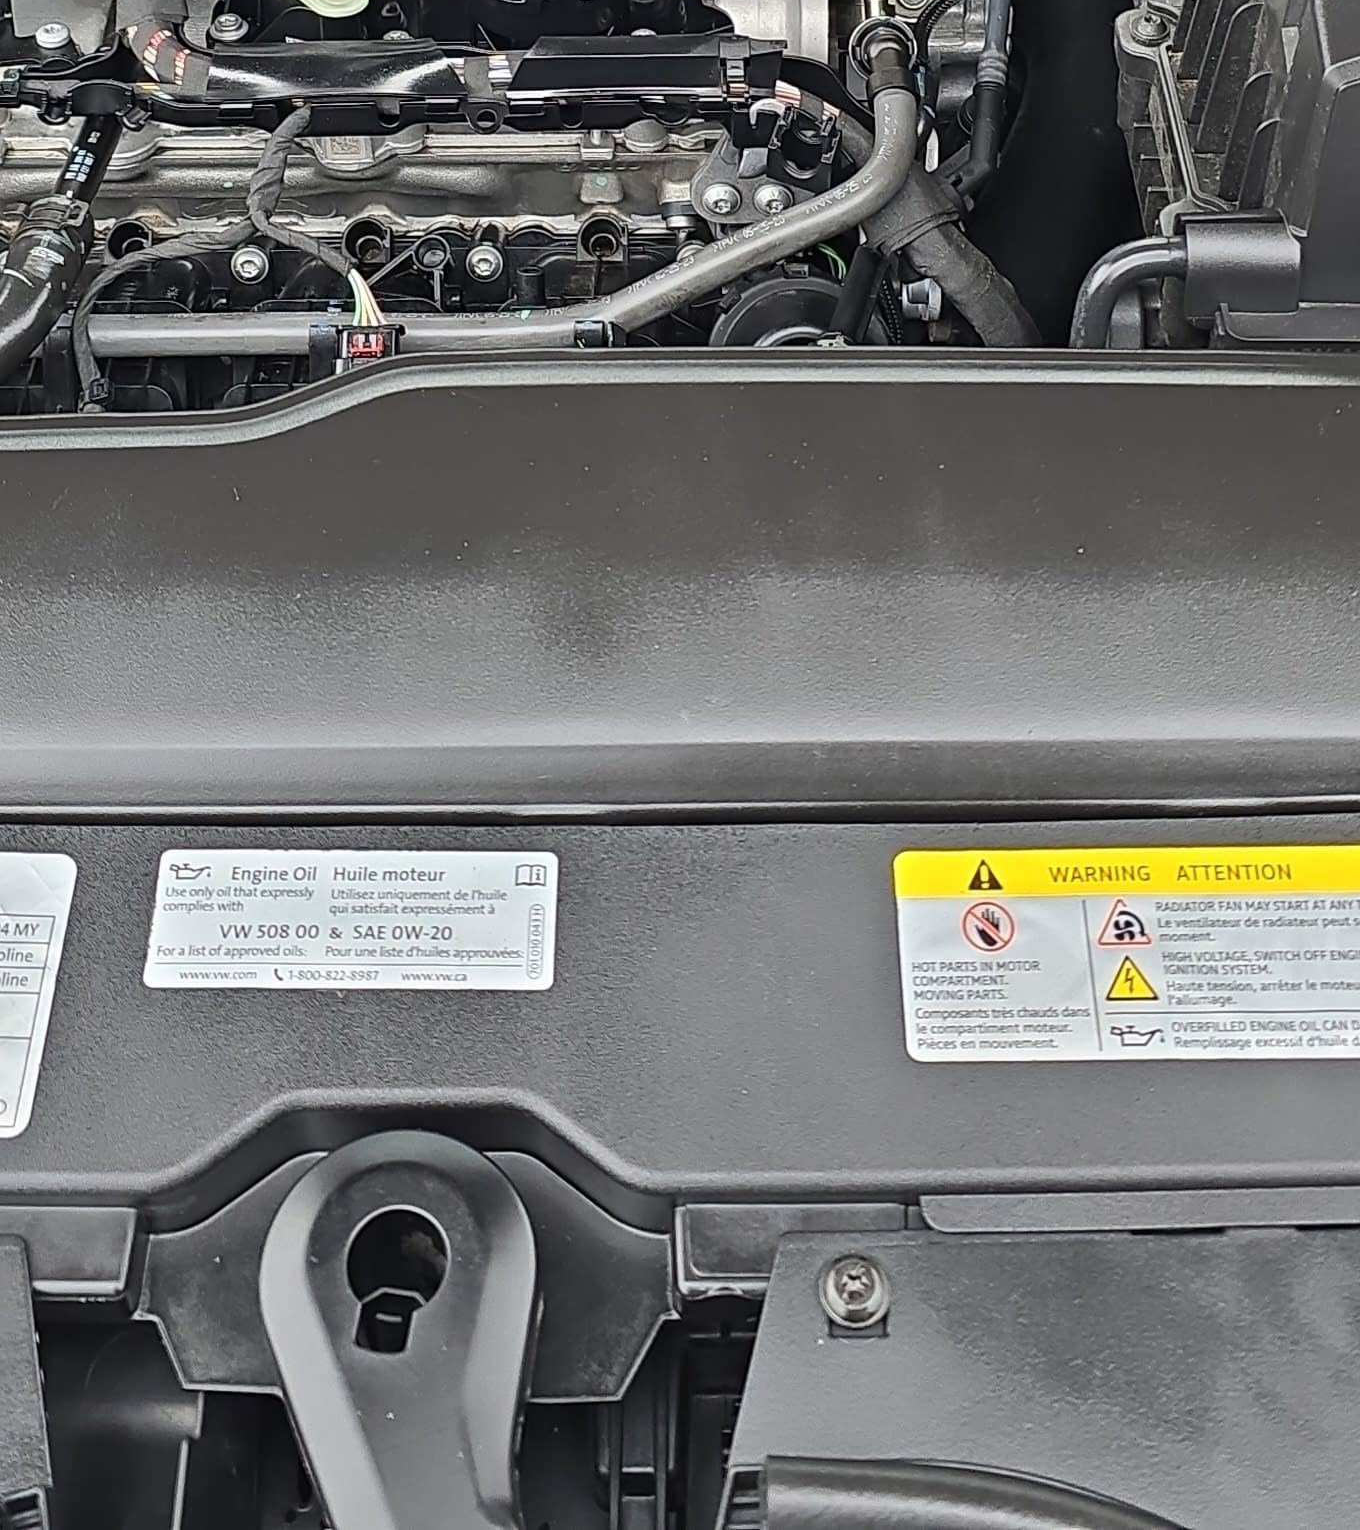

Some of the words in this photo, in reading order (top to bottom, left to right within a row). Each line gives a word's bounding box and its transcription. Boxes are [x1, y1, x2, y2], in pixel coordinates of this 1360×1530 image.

[231, 866, 289, 885] Engine
[293, 866, 317, 881] Oil
[333, 866, 378, 882] Huile
[382, 868, 445, 882] moteur
[1049, 865, 1150, 883] WARNING
[1177, 864, 1291, 881] ATTENTION
[165, 886, 187, 898] Use
[188, 886, 215, 901] only
[216, 886, 232, 898] oil
[233, 886, 258, 898] that
[260, 886, 314, 901] expressly
[331, 888, 375, 900] Utilisez
[377, 889, 451, 902] uniquement
[453, 889, 469, 901] de
[471, 889, 508, 901] l'huile
[163, 900, 215, 914] complies
[217, 900, 244, 912] with
[329, 903, 349, 917] qui
[351, 902, 399, 914] satisfait
[401, 903, 485, 917] expressément
[487, 903, 496, 915] à
[1155, 901, 1215, 912] RADIATOR
[1217, 900, 1243, 911] FAN
[1245, 901, 1271, 912] MAY
[1273, 900, 1309, 912] START
[1312, 899, 1326, 911] AT
[1329, 900, 1354, 910] ANY
[13, 923, 40, 936] MY
[1157, 917, 1173, 929] Le
[1174, 917, 1241, 928] ventilateur
[1244, 916, 1260, 928] de
[1262, 916, 1319, 928] radiateur
[1321, 917, 1352, 928] peut
[220, 924, 253, 939] VW
[257, 924, 290, 939] 508
[295, 924, 320, 939] 00
[329, 926, 343, 940] &
[353, 925, 386, 940] SAE
[392, 925, 453, 941] 0W-20
[1159, 932, 1216, 942] moment.
[156, 945, 176, 957] For
[177, 947, 186, 957] a
[188, 944, 206, 957] list
[208, 944, 223, 957] of
[223, 944, 281, 959] approved
[282, 945, 307, 957] oils:
[325, 945, 353, 957] Pour
[354, 948, 378, 958] une
[379, 945, 404, 958] liste
[405, 945, 451, 958] d'huiles
[1161, 951, 1193, 963] HIGH
[1194, 950, 1252, 963] VOLTAGE,
[1253, 950, 1301, 962] SWITCH
[1303, 949, 1327, 961] OFF
[911, 961, 937, 973] HOT
[939, 961, 978, 972] PARTS
[980, 961, 994, 972] IN
[996, 960, 1041, 972] MOTOR
[1163, 964, 1219, 975] IGNITION
[1221, 964, 1272, 975] SYSTEM.
[179, 971, 257, 980] www.vw.com
[913, 974, 1008, 987] COMPARTMENT.
[1166, 980, 1204, 992] Haute
[1206, 980, 1257, 993] tension,
[1260, 979, 1303, 992] arrêter
[1305, 979, 1318, 991] le
[914, 989, 965, 1001] MOVING
[966, 988, 1008, 1000] PARTS.
[915, 1007, 990, 1021] Composants
[991, 1006, 1015, 1019] très
[1016, 1006, 1060, 1018] chauds
[1061, 1006, 1091, 1018] dans
[915, 1022, 928, 1035] le
[930, 1023, 1020, 1036] compartiment
[1023, 1023, 1073, 1033] moteur.
[1171, 1021, 1247, 1033] OVERFILLED
[1249, 1020, 1297, 1032] ENGINE
[1298, 1020, 1321, 1032] OIL
[1322, 1019, 1349, 1032] CAN
[917, 1037, 957, 1050] Pièces
[959, 1040, 977, 1050] en
[979, 1039, 1058, 1049] mouvement.
[1174, 1036, 1251, 1050] Remplissage
[1255, 1035, 1303, 1048] excessif
